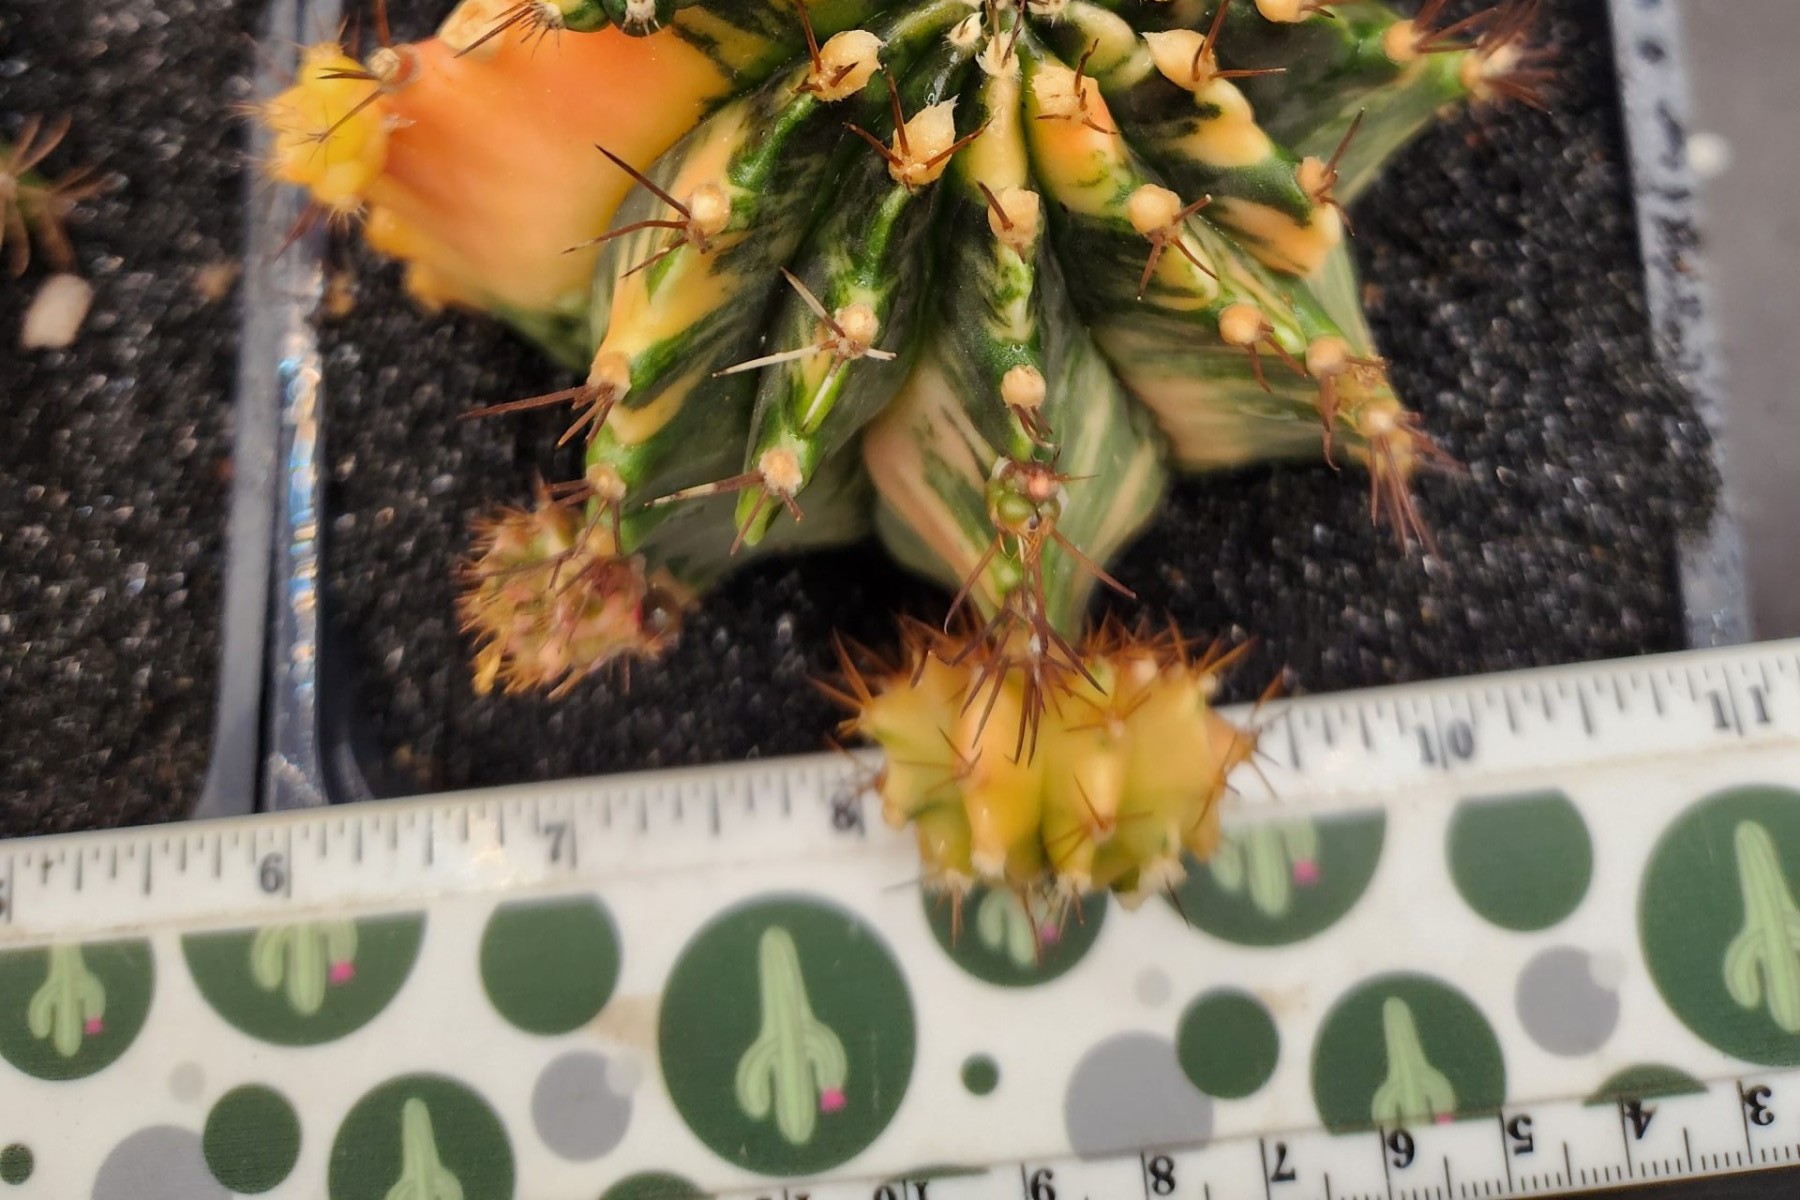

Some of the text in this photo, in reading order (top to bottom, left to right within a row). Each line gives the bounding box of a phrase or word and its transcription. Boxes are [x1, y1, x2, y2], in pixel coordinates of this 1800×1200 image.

[1708, 684, 1771, 730] 11
[1416, 718, 1475, 764] 10
[544, 821, 567, 863] 7
[259, 852, 285, 893] 6
[1625, 1100, 1656, 1140] 4
[1746, 1085, 1775, 1126] 3
[1388, 1128, 1415, 1168] 6
[1507, 1114, 1533, 1155] 5
[1150, 1155, 1175, 1195] 8
[1272, 1142, 1296, 1182] 7
